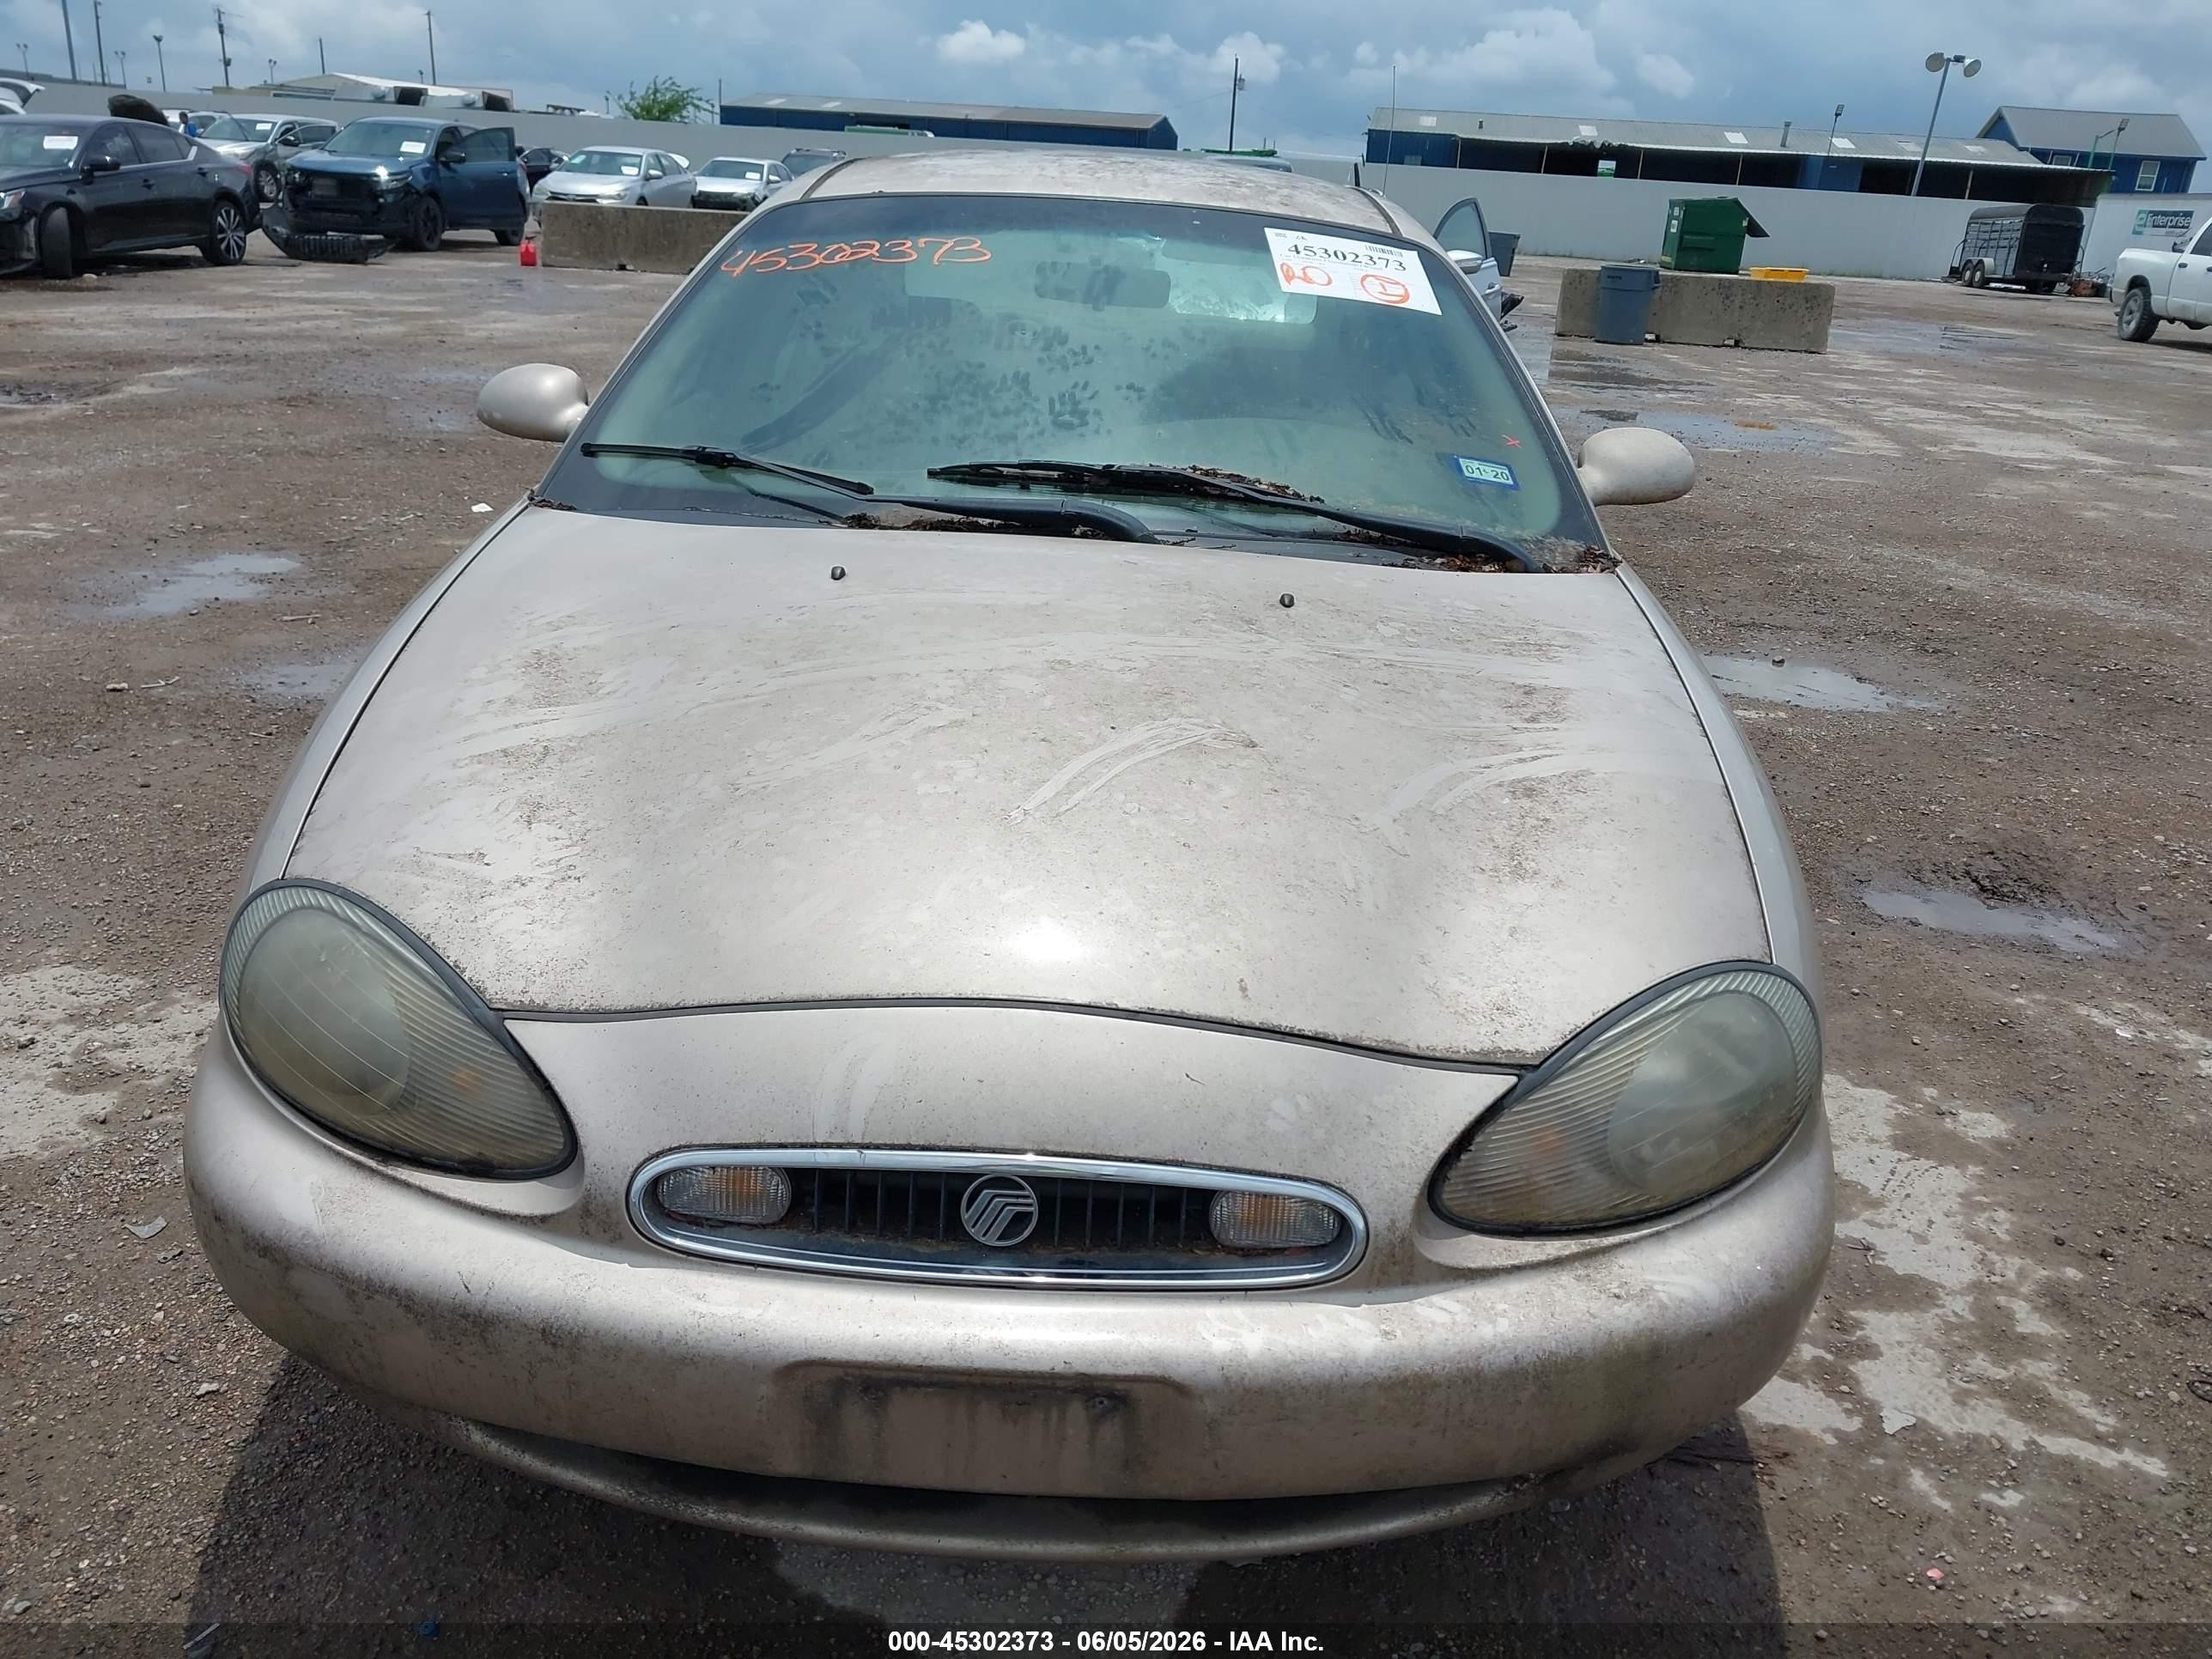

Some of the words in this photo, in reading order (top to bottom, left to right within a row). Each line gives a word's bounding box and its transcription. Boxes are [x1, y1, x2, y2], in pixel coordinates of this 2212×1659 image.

[2146, 213, 2191, 228] Enterprise
[720, 237, 992, 276] 45302373
[1287, 244, 1407, 271] 45302373
